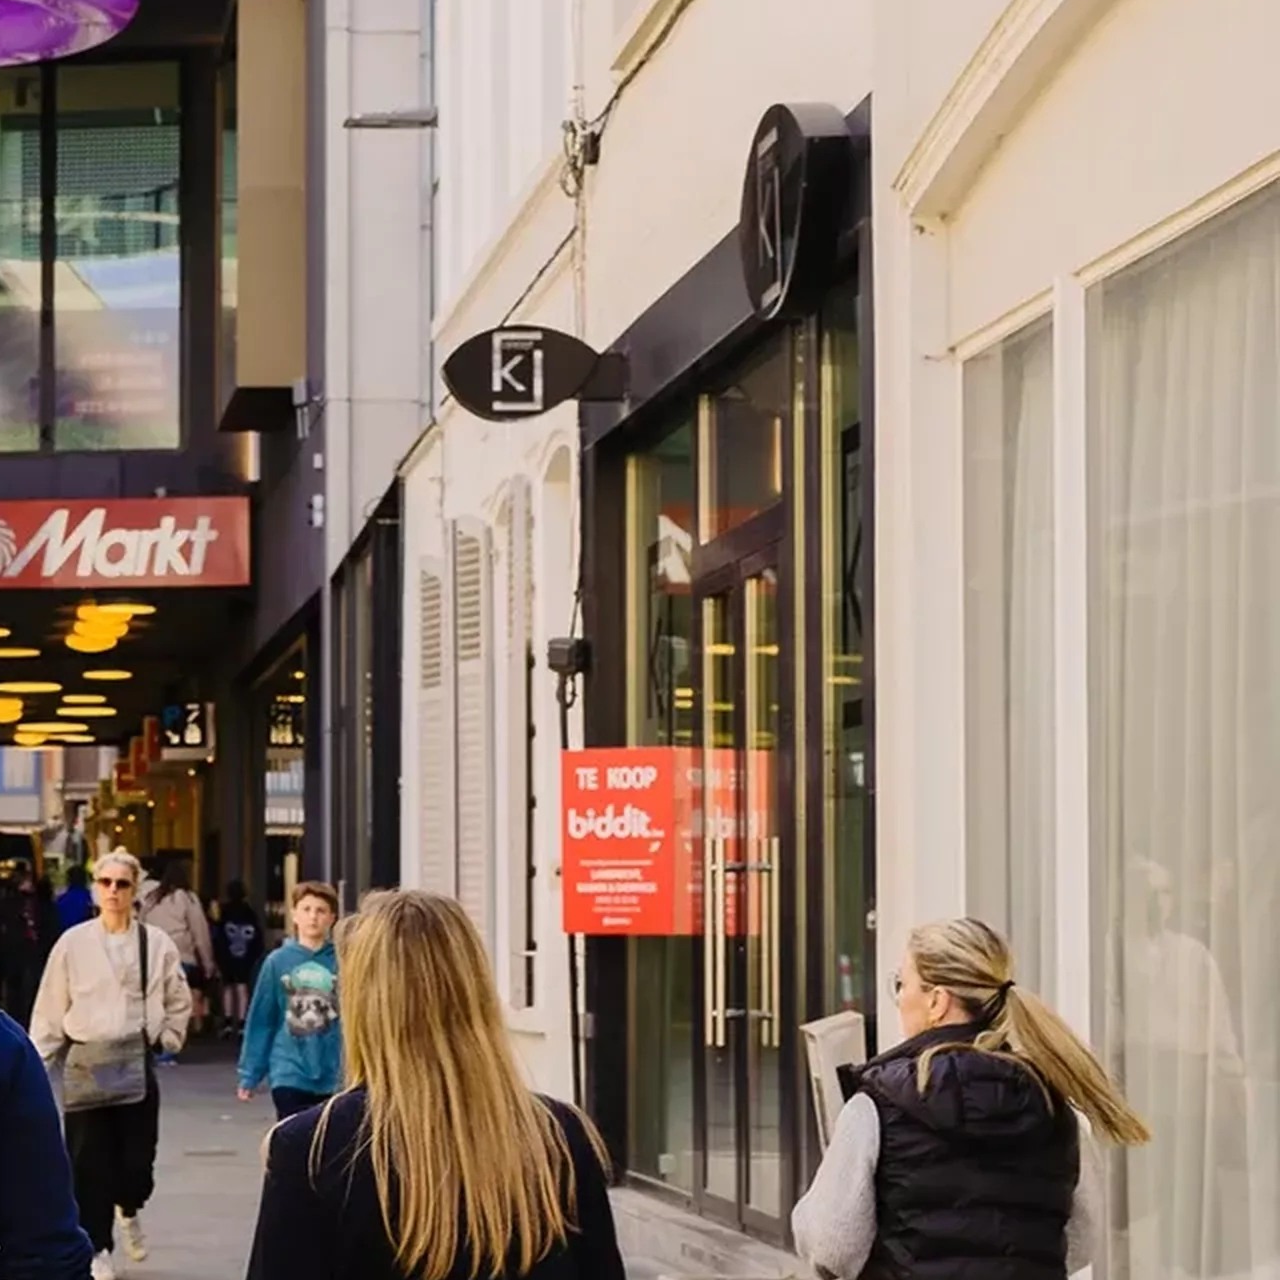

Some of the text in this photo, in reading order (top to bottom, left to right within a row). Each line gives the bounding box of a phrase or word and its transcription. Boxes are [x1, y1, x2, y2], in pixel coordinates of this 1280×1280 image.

[8, 507, 219, 578] Markt
[575, 766, 599, 791] TE
[606, 765, 658, 790] KOOP
